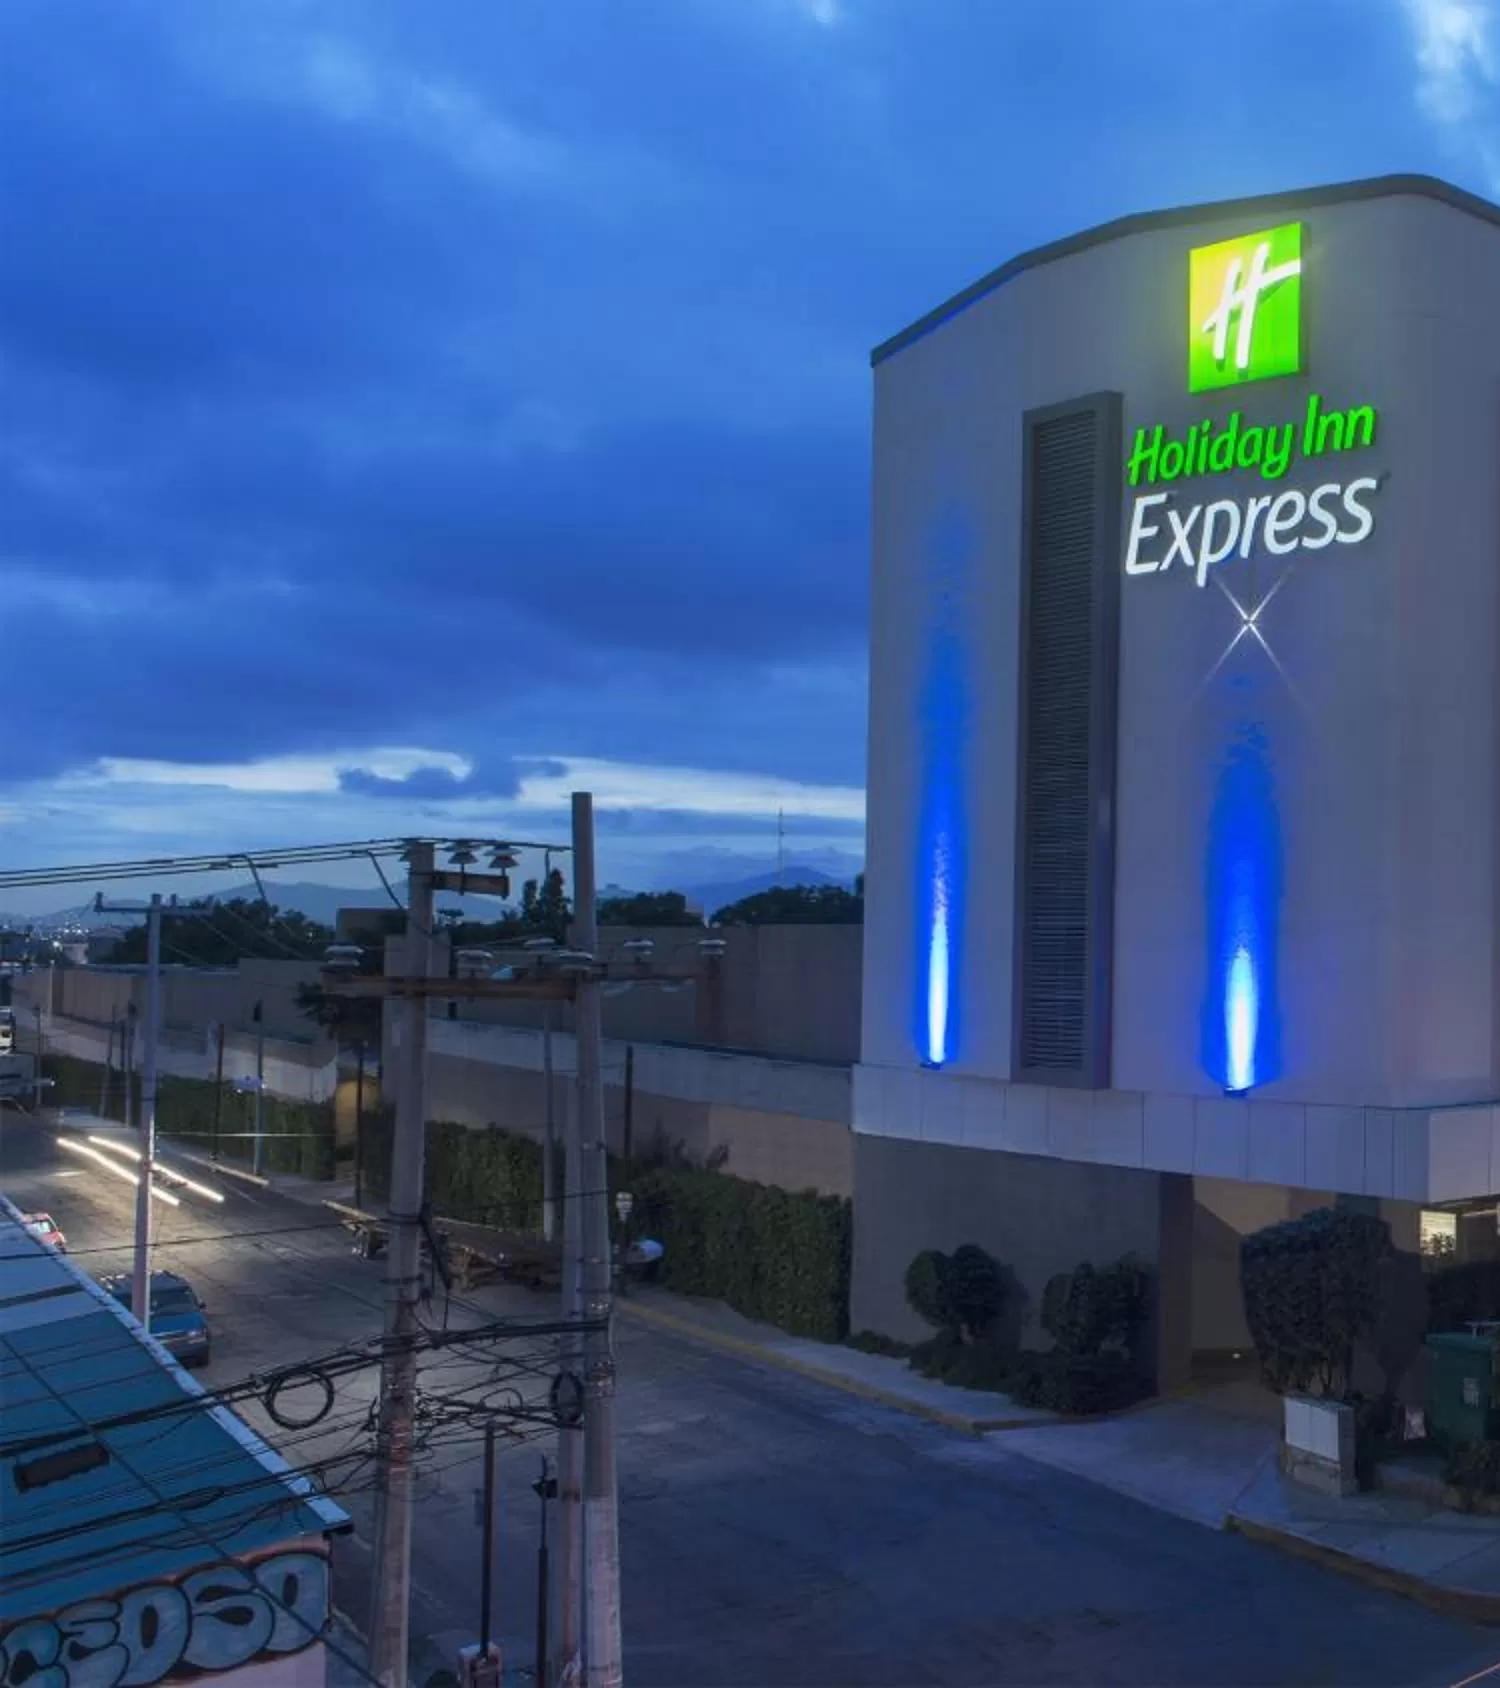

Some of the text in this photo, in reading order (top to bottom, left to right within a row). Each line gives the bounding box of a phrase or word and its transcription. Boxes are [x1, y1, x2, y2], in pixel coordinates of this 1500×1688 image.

[1202, 242, 1302, 369] H
[1128, 394, 1375, 484] Holiday Inn
[1125, 477, 1377, 588] Express
